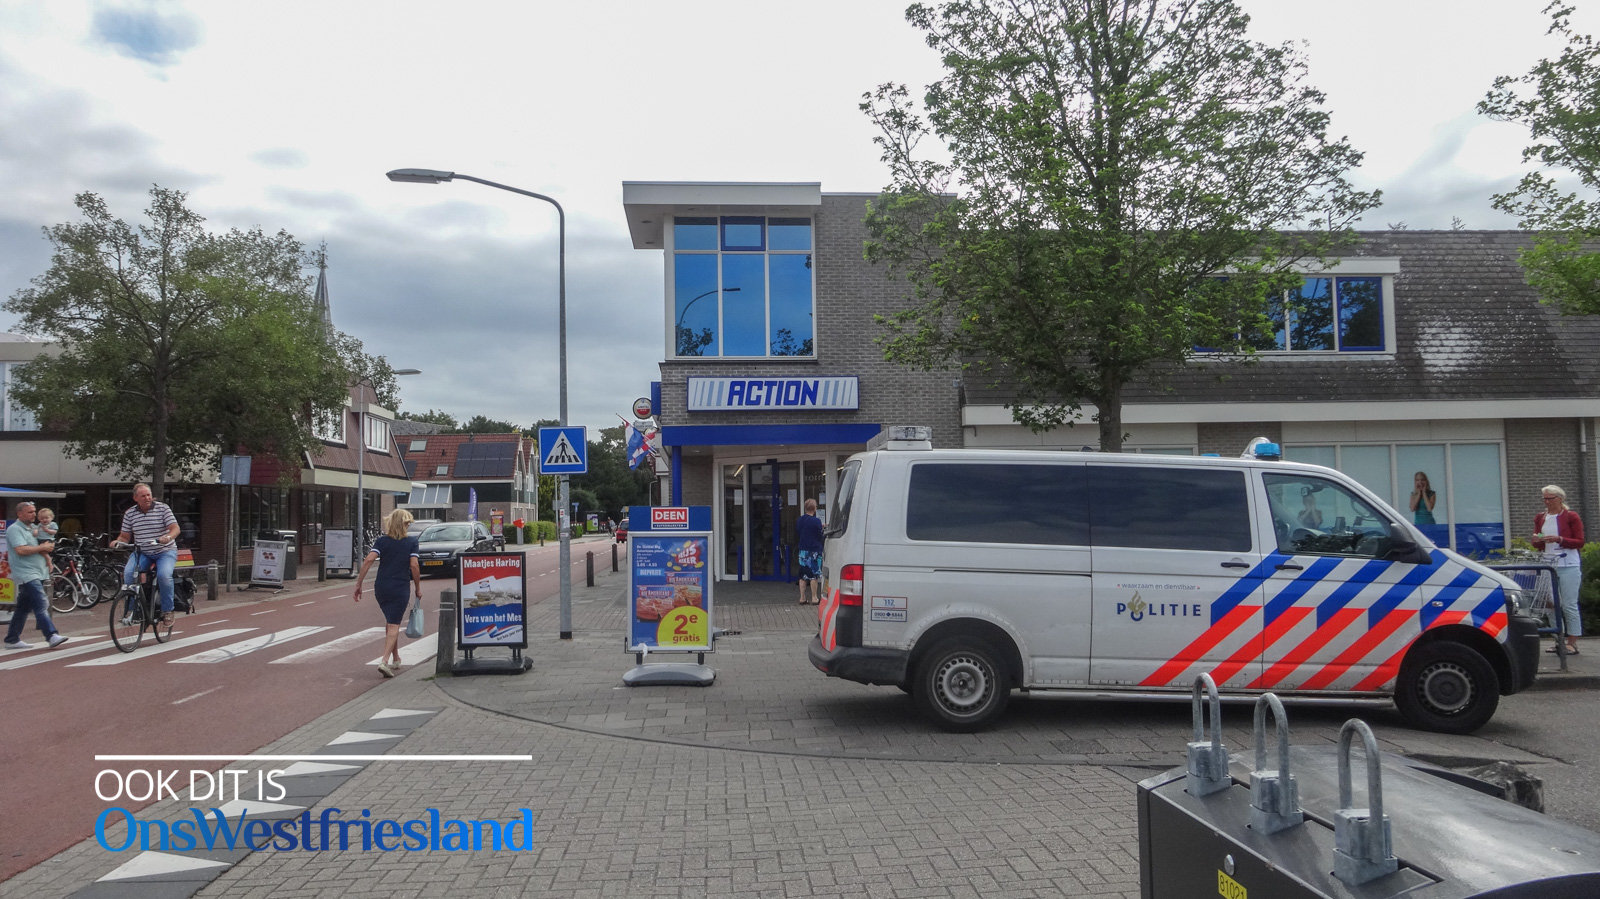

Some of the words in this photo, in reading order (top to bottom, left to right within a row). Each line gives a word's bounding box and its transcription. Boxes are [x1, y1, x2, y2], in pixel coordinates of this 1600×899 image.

[727, 380, 819, 406] ACTION
[655, 511, 685, 520] DEEN
[464, 559, 495, 569] Maatjes
[495, 558, 520, 568] Haring
[464, 614, 479, 623] Vers
[480, 614, 493, 623] van
[495, 613, 506, 622] het
[507, 612, 522, 622] Mes
[1117, 603, 1201, 621] POLITIE
[673, 634, 700, 644] gratis
